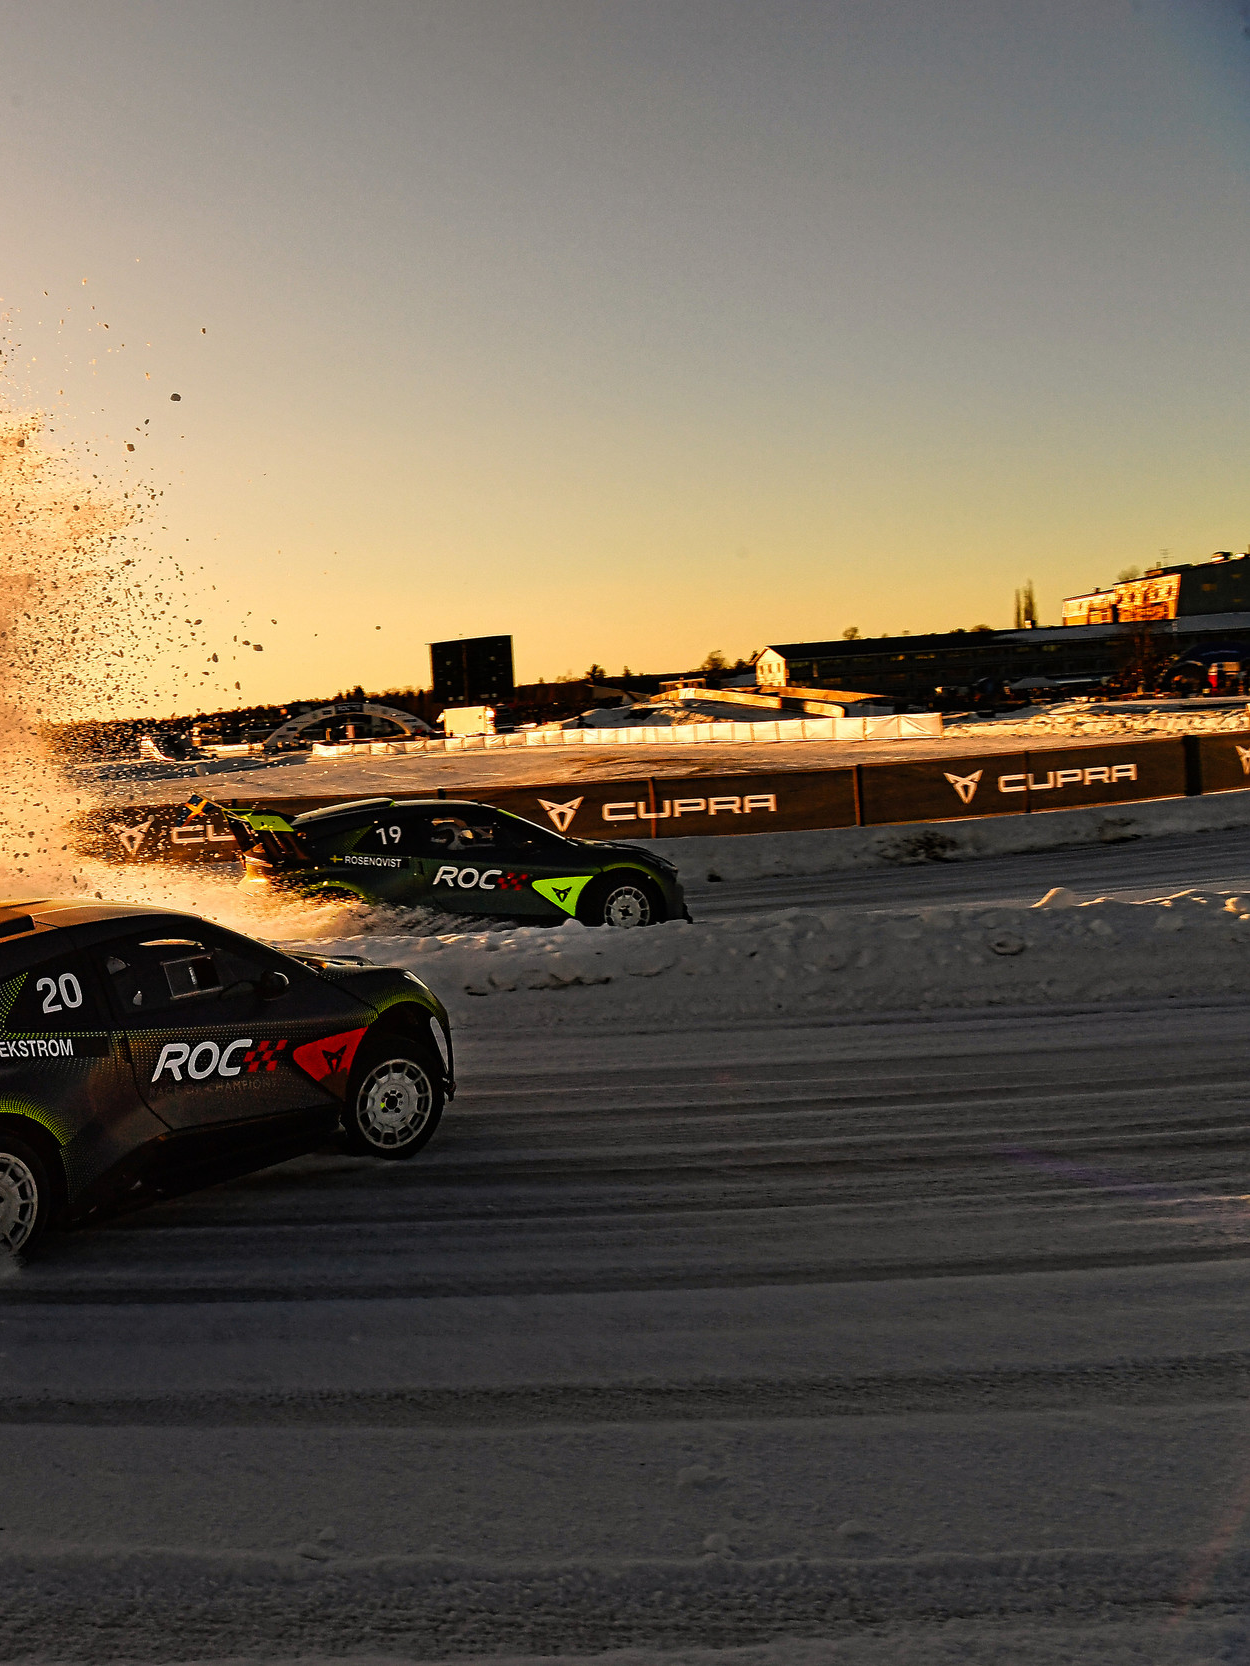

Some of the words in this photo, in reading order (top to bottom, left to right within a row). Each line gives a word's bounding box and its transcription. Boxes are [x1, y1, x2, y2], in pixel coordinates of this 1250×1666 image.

[997, 763, 1138, 793] CUPRA
[601, 793, 777, 821] CUPRA
[375, 825, 402, 845] 19
[344, 855, 402, 868] ROSENQVIST
[432, 865, 503, 890] ROC
[36, 972, 83, 1014] 20
[151, 1038, 253, 1083] ROC
